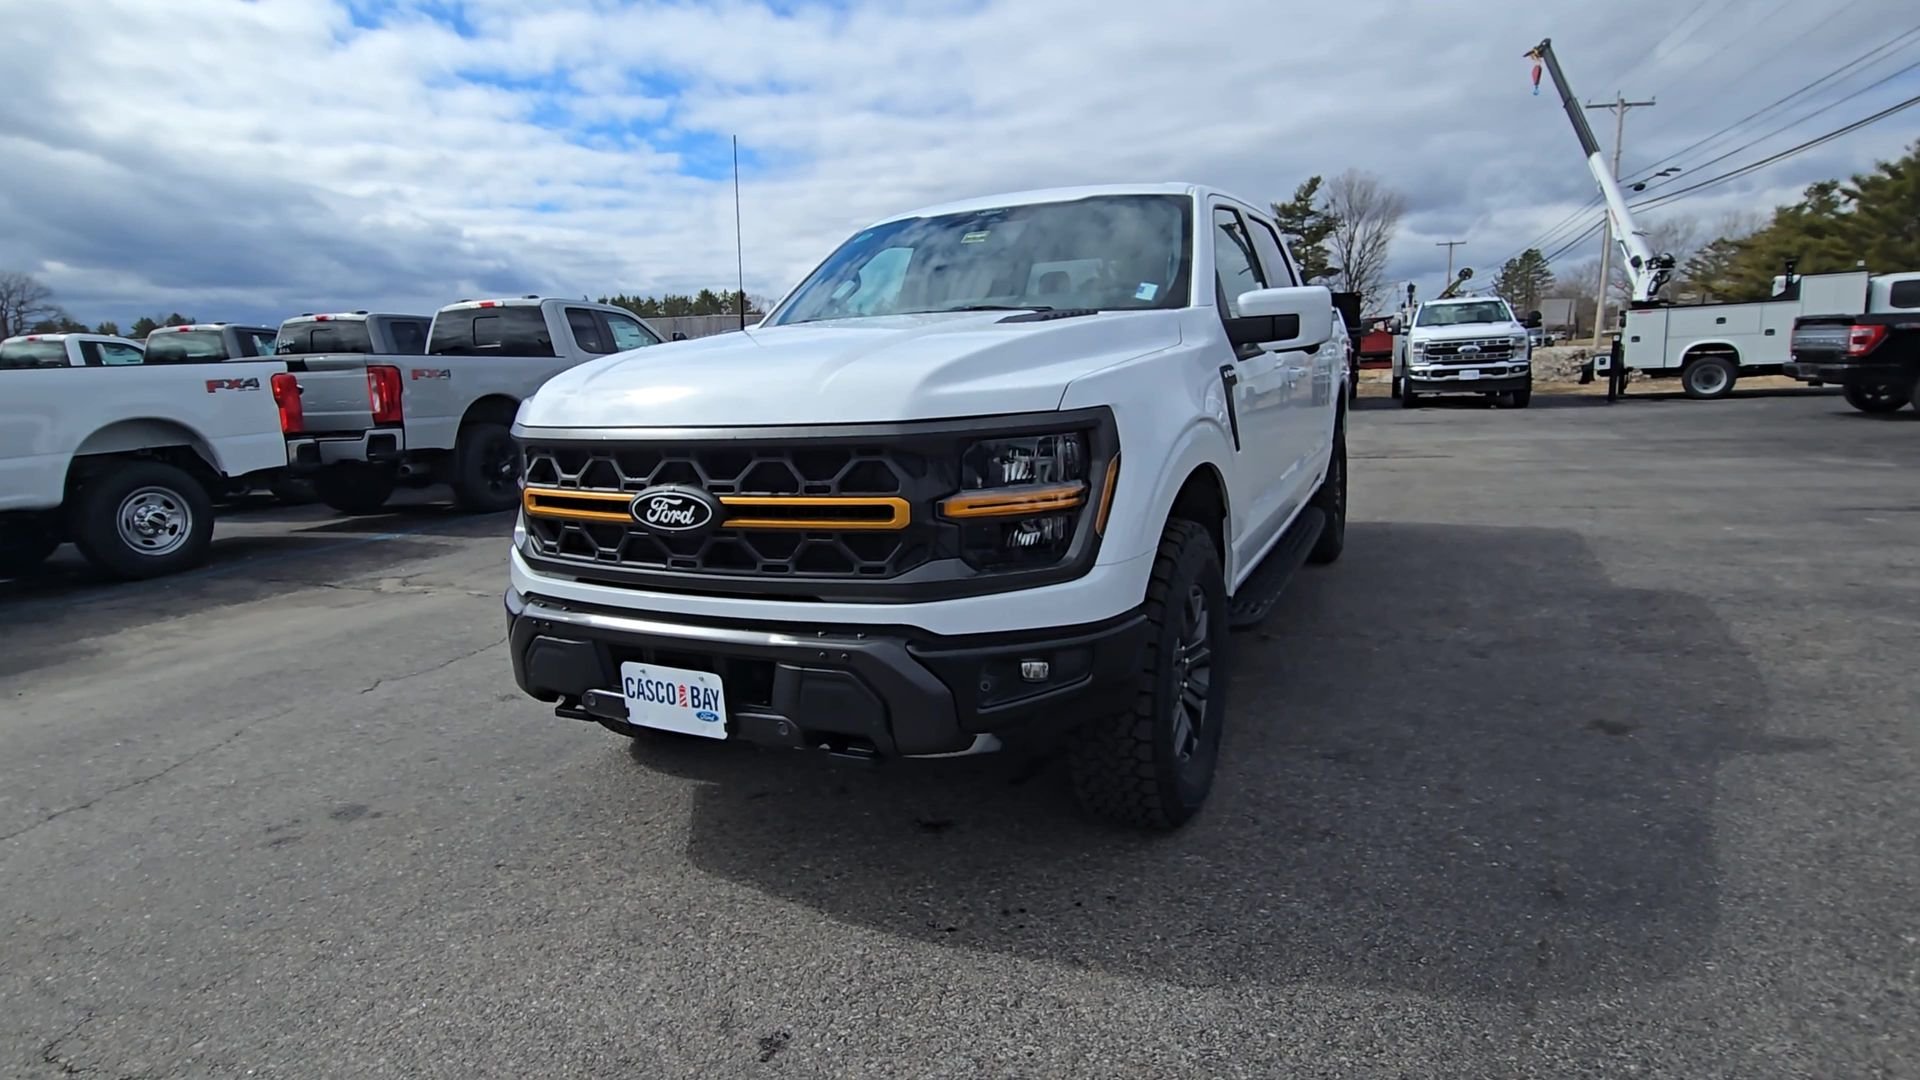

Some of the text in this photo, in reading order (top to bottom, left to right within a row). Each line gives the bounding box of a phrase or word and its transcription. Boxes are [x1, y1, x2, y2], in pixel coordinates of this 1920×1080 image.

[411, 368, 451, 379] FX4
[206, 378, 260, 393] FX4
[647, 497, 695, 523] Ford
[625, 677, 719, 711] CASCO BAY
